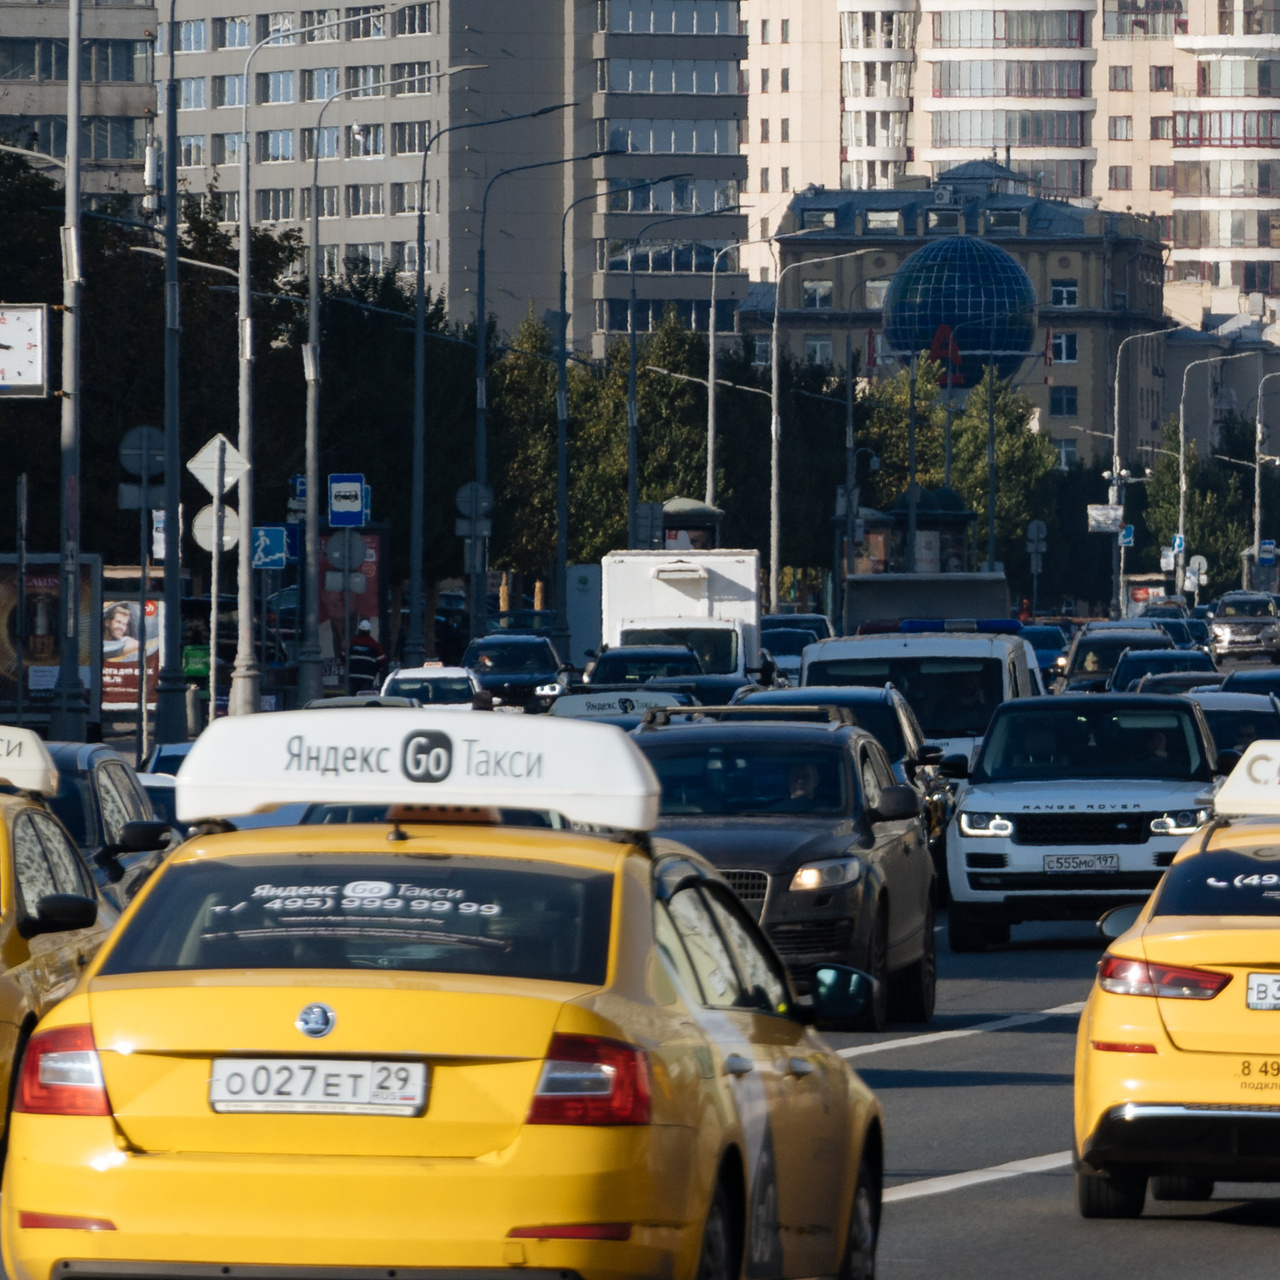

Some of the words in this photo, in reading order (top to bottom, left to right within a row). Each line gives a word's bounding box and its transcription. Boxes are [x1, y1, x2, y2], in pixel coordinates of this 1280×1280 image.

[284, 735, 390, 775] Яндекс
[405, 736, 448, 775] Go
[462, 739, 543, 778] Такси
[1096, 856, 1114, 866] 197
[251, 884, 340, 899] Яндекс
[396, 883, 465, 898] Такси
[341, 898, 401, 909] 999
[410, 900, 451, 911] 99
[458, 903, 501, 915] 99
[1241, 1060, 1252, 1076] 8
[225, 1065, 364, 1097] О027ЕТ
[376, 1066, 410, 1091] 29
